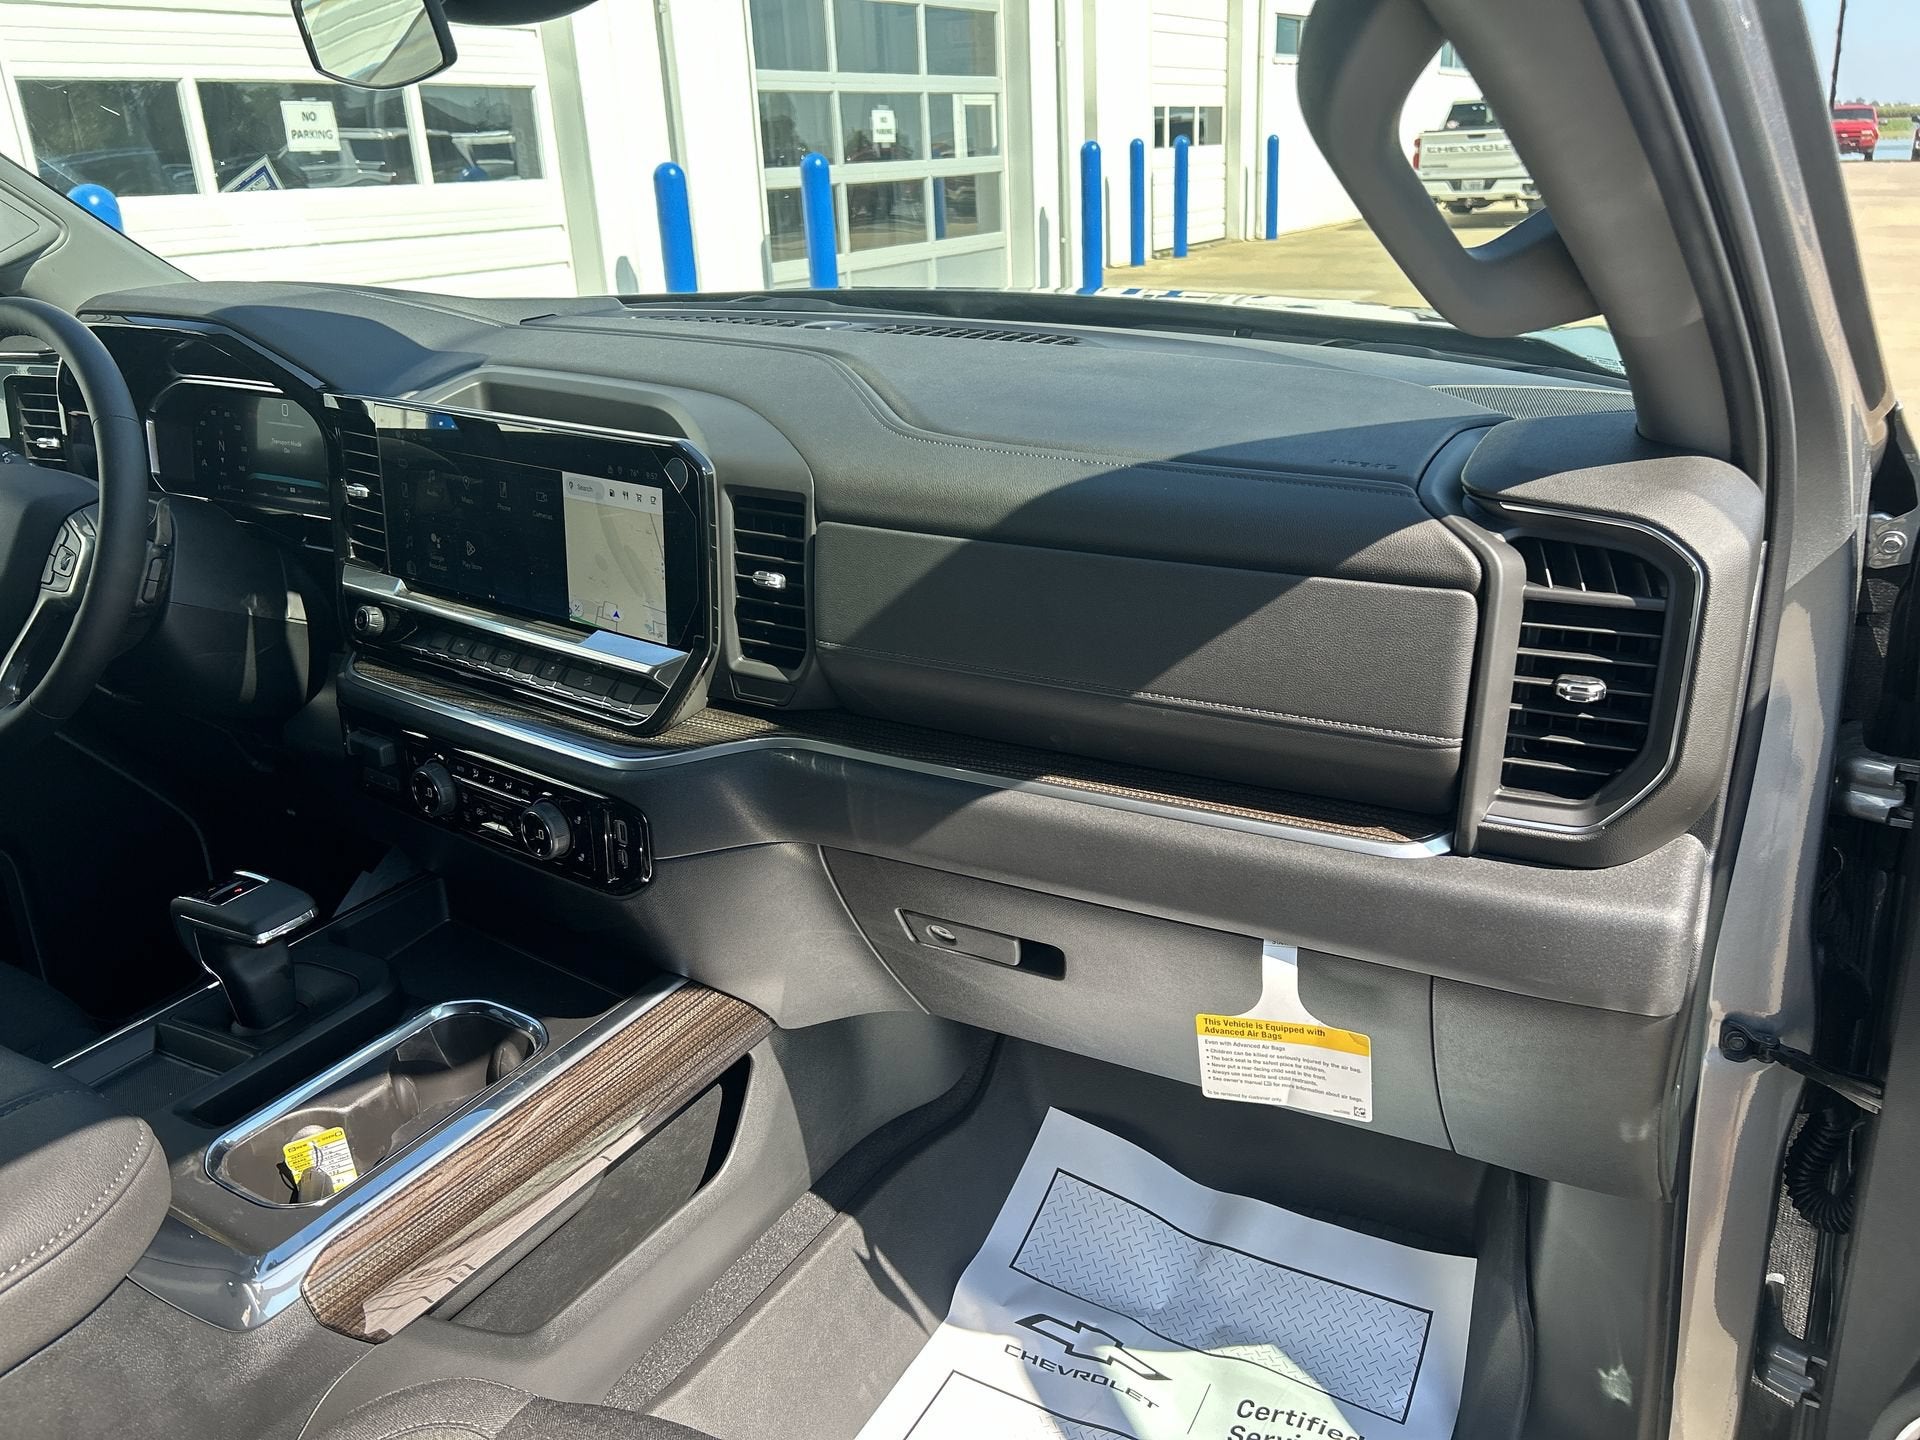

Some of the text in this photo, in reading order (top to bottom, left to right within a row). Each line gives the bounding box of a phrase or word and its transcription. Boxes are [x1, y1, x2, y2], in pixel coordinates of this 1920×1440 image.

[301, 111, 317, 122] NO
[291, 129, 333, 140] PARKING
[576, 483, 594, 494] Search
[1204, 1017, 1326, 1037] This Vehicle is Equipped with
[1204, 1026, 1283, 1041] Advanced Air Bags
[1233, 1041, 1261, 1050] Advanced
[1276, 1055, 1301, 1063] seriously
[1302, 1057, 1322, 1066] injured
[1322, 1060, 1330, 1068] by
[1295, 1084, 1326, 1095] information
[1325, 1090, 1341, 1098] about
[1004, 1343, 1160, 1409] CHEVROLET
